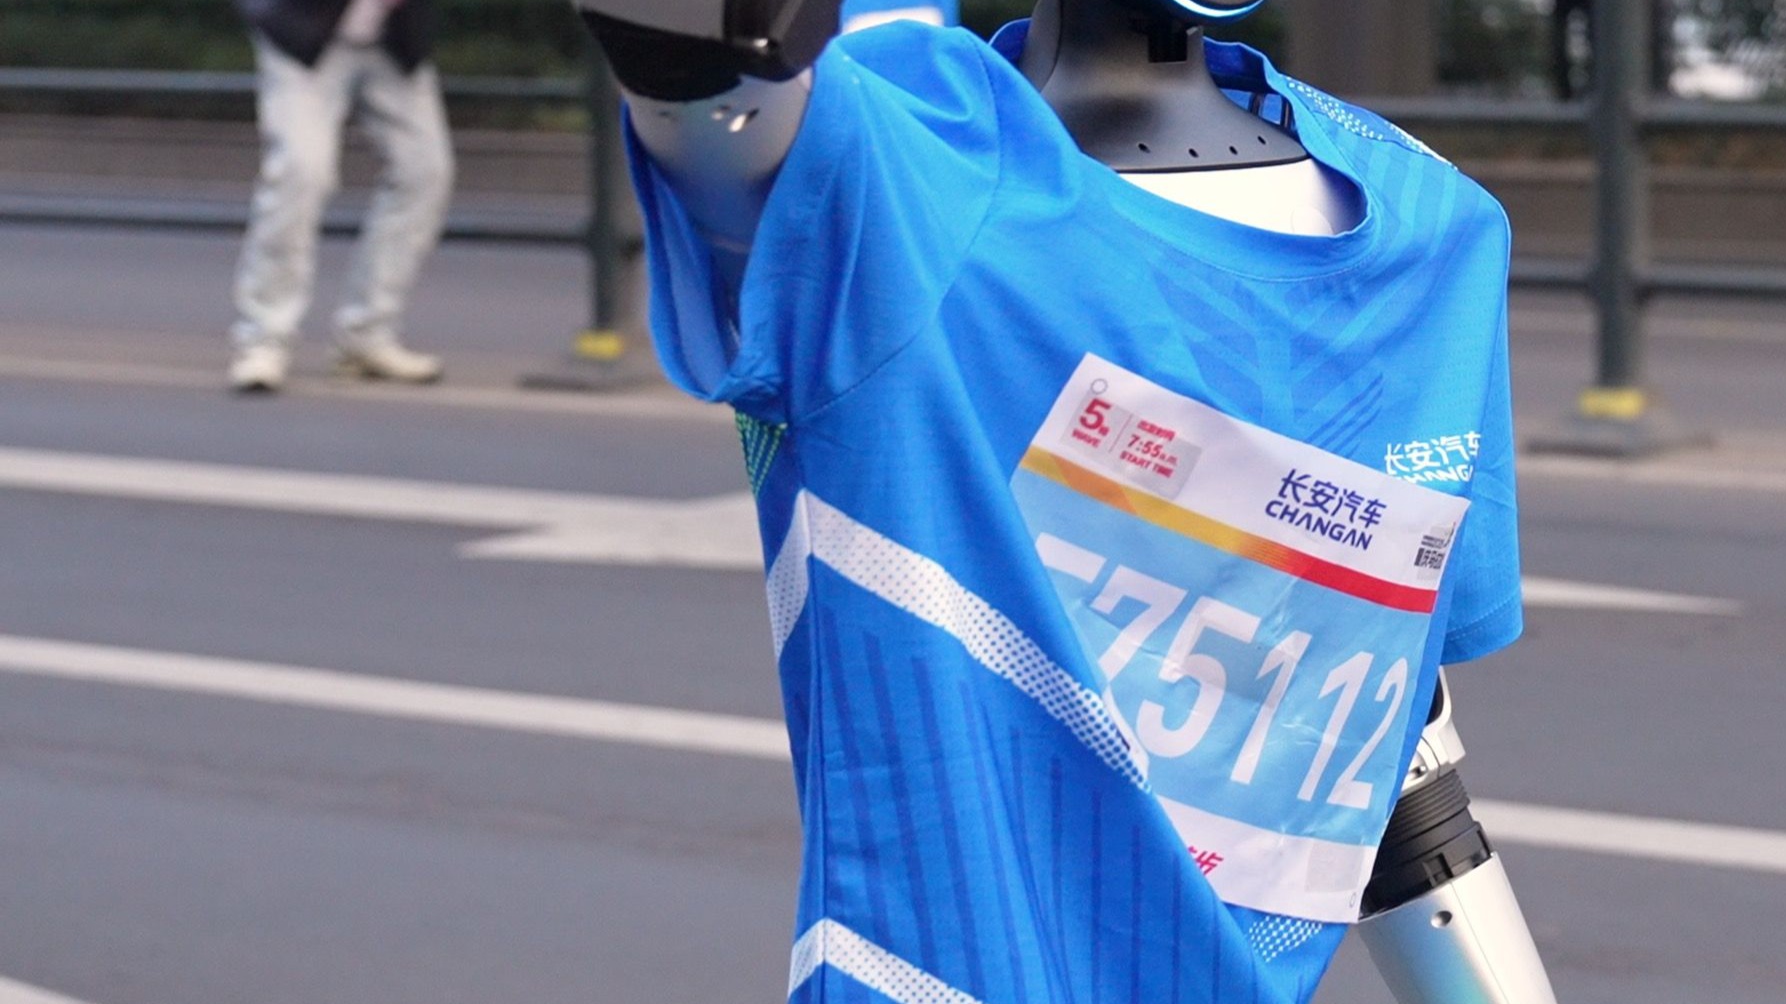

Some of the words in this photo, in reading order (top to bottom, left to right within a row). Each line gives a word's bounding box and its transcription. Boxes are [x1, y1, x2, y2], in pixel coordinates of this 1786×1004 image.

[1119, 450, 1151, 469] START
[1265, 499, 1373, 550] CHANGAN
[1278, 468, 1387, 528] 长安汽车
[1034, 531, 1409, 810] 75112
